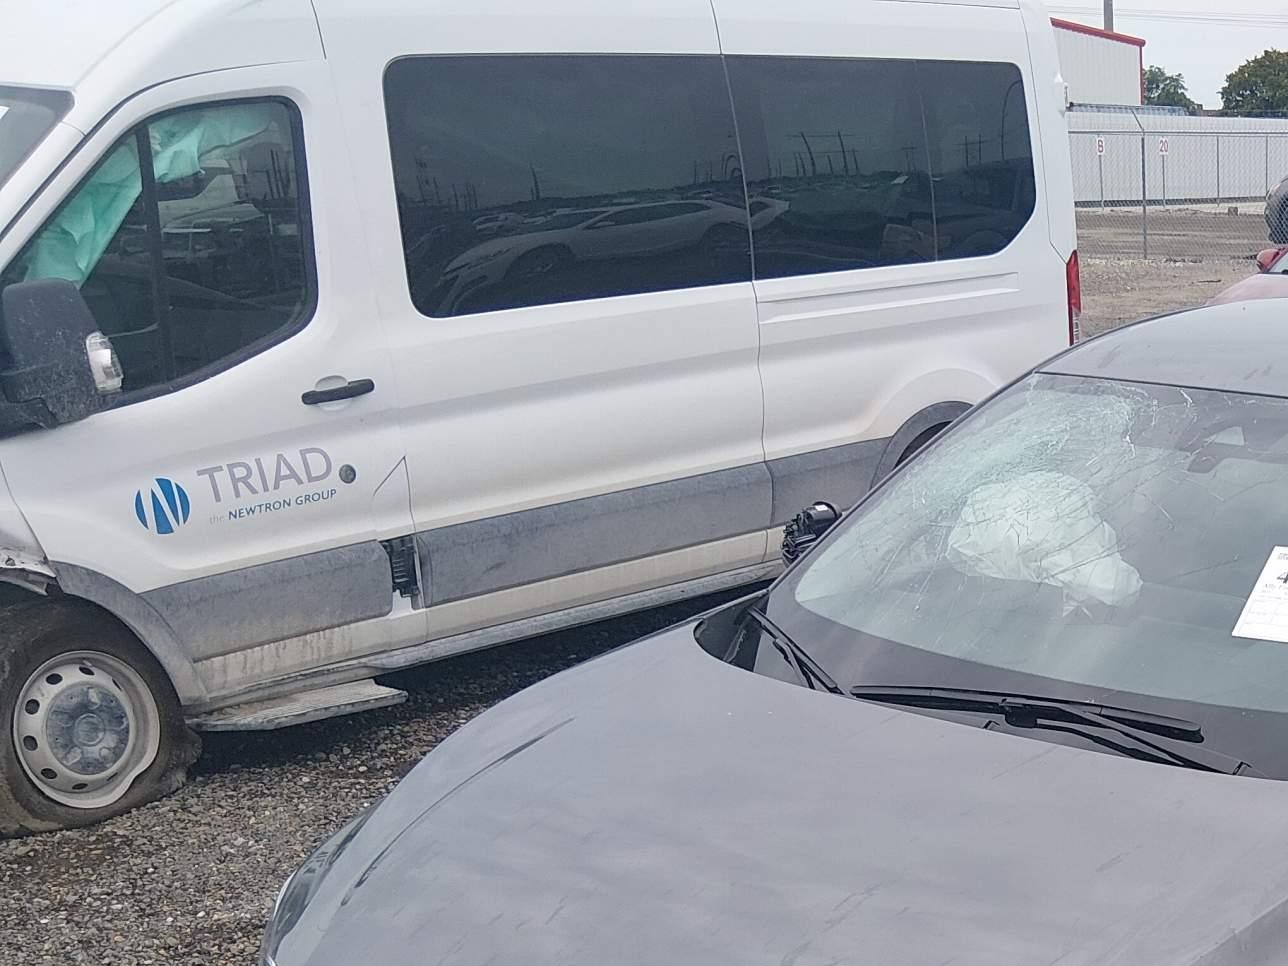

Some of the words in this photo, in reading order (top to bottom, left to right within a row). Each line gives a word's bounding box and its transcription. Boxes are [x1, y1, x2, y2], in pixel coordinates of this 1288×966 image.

[197, 447, 333, 503] TRIAD
[228, 498, 291, 521] NEWTRON
[295, 488, 337, 506] GROUP
